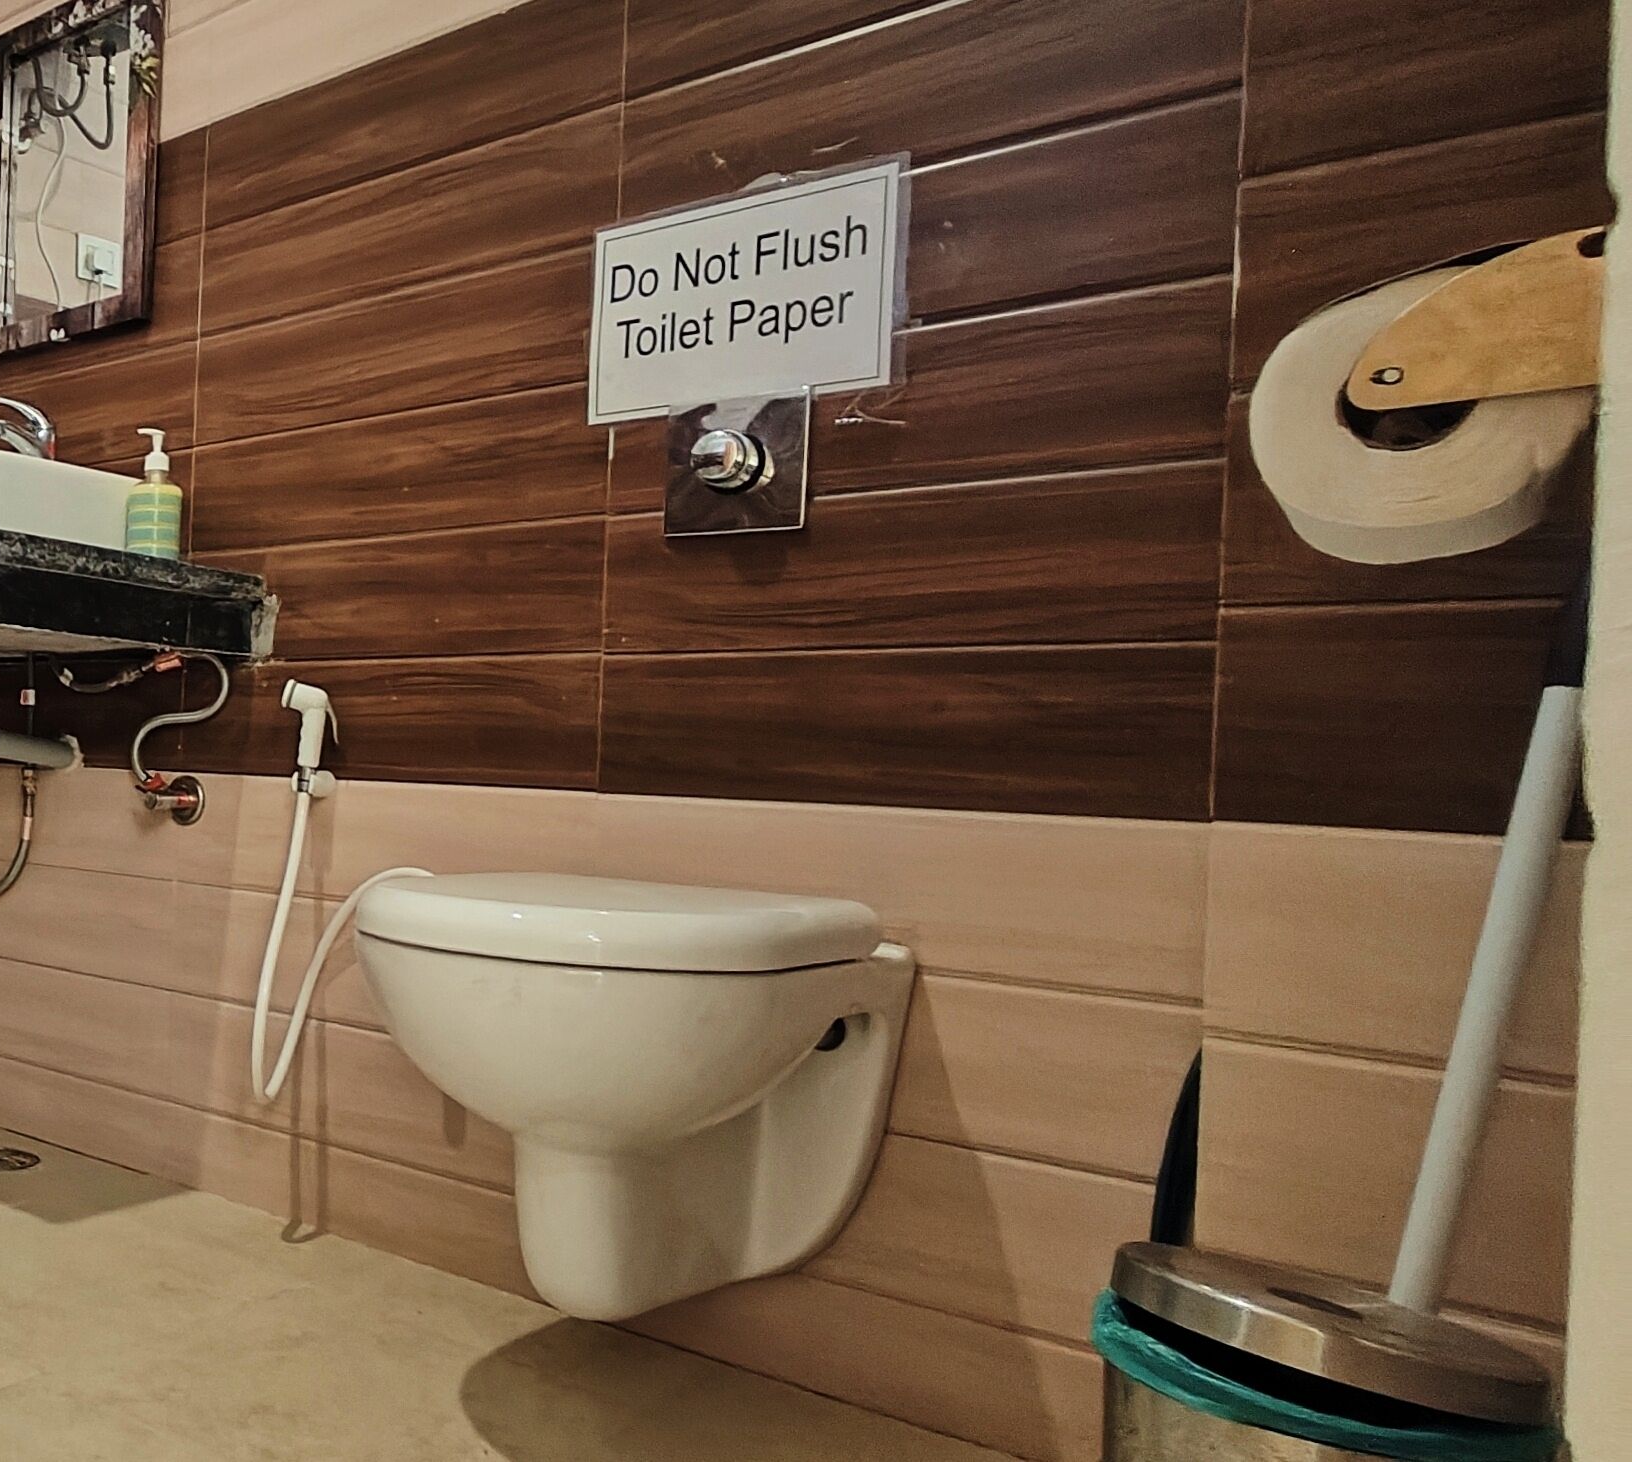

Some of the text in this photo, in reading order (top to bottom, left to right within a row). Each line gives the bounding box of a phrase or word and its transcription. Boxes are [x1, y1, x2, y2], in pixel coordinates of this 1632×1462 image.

[610, 215, 868, 304] Do Not Flush
[617, 290, 854, 359] Toilet Paper
